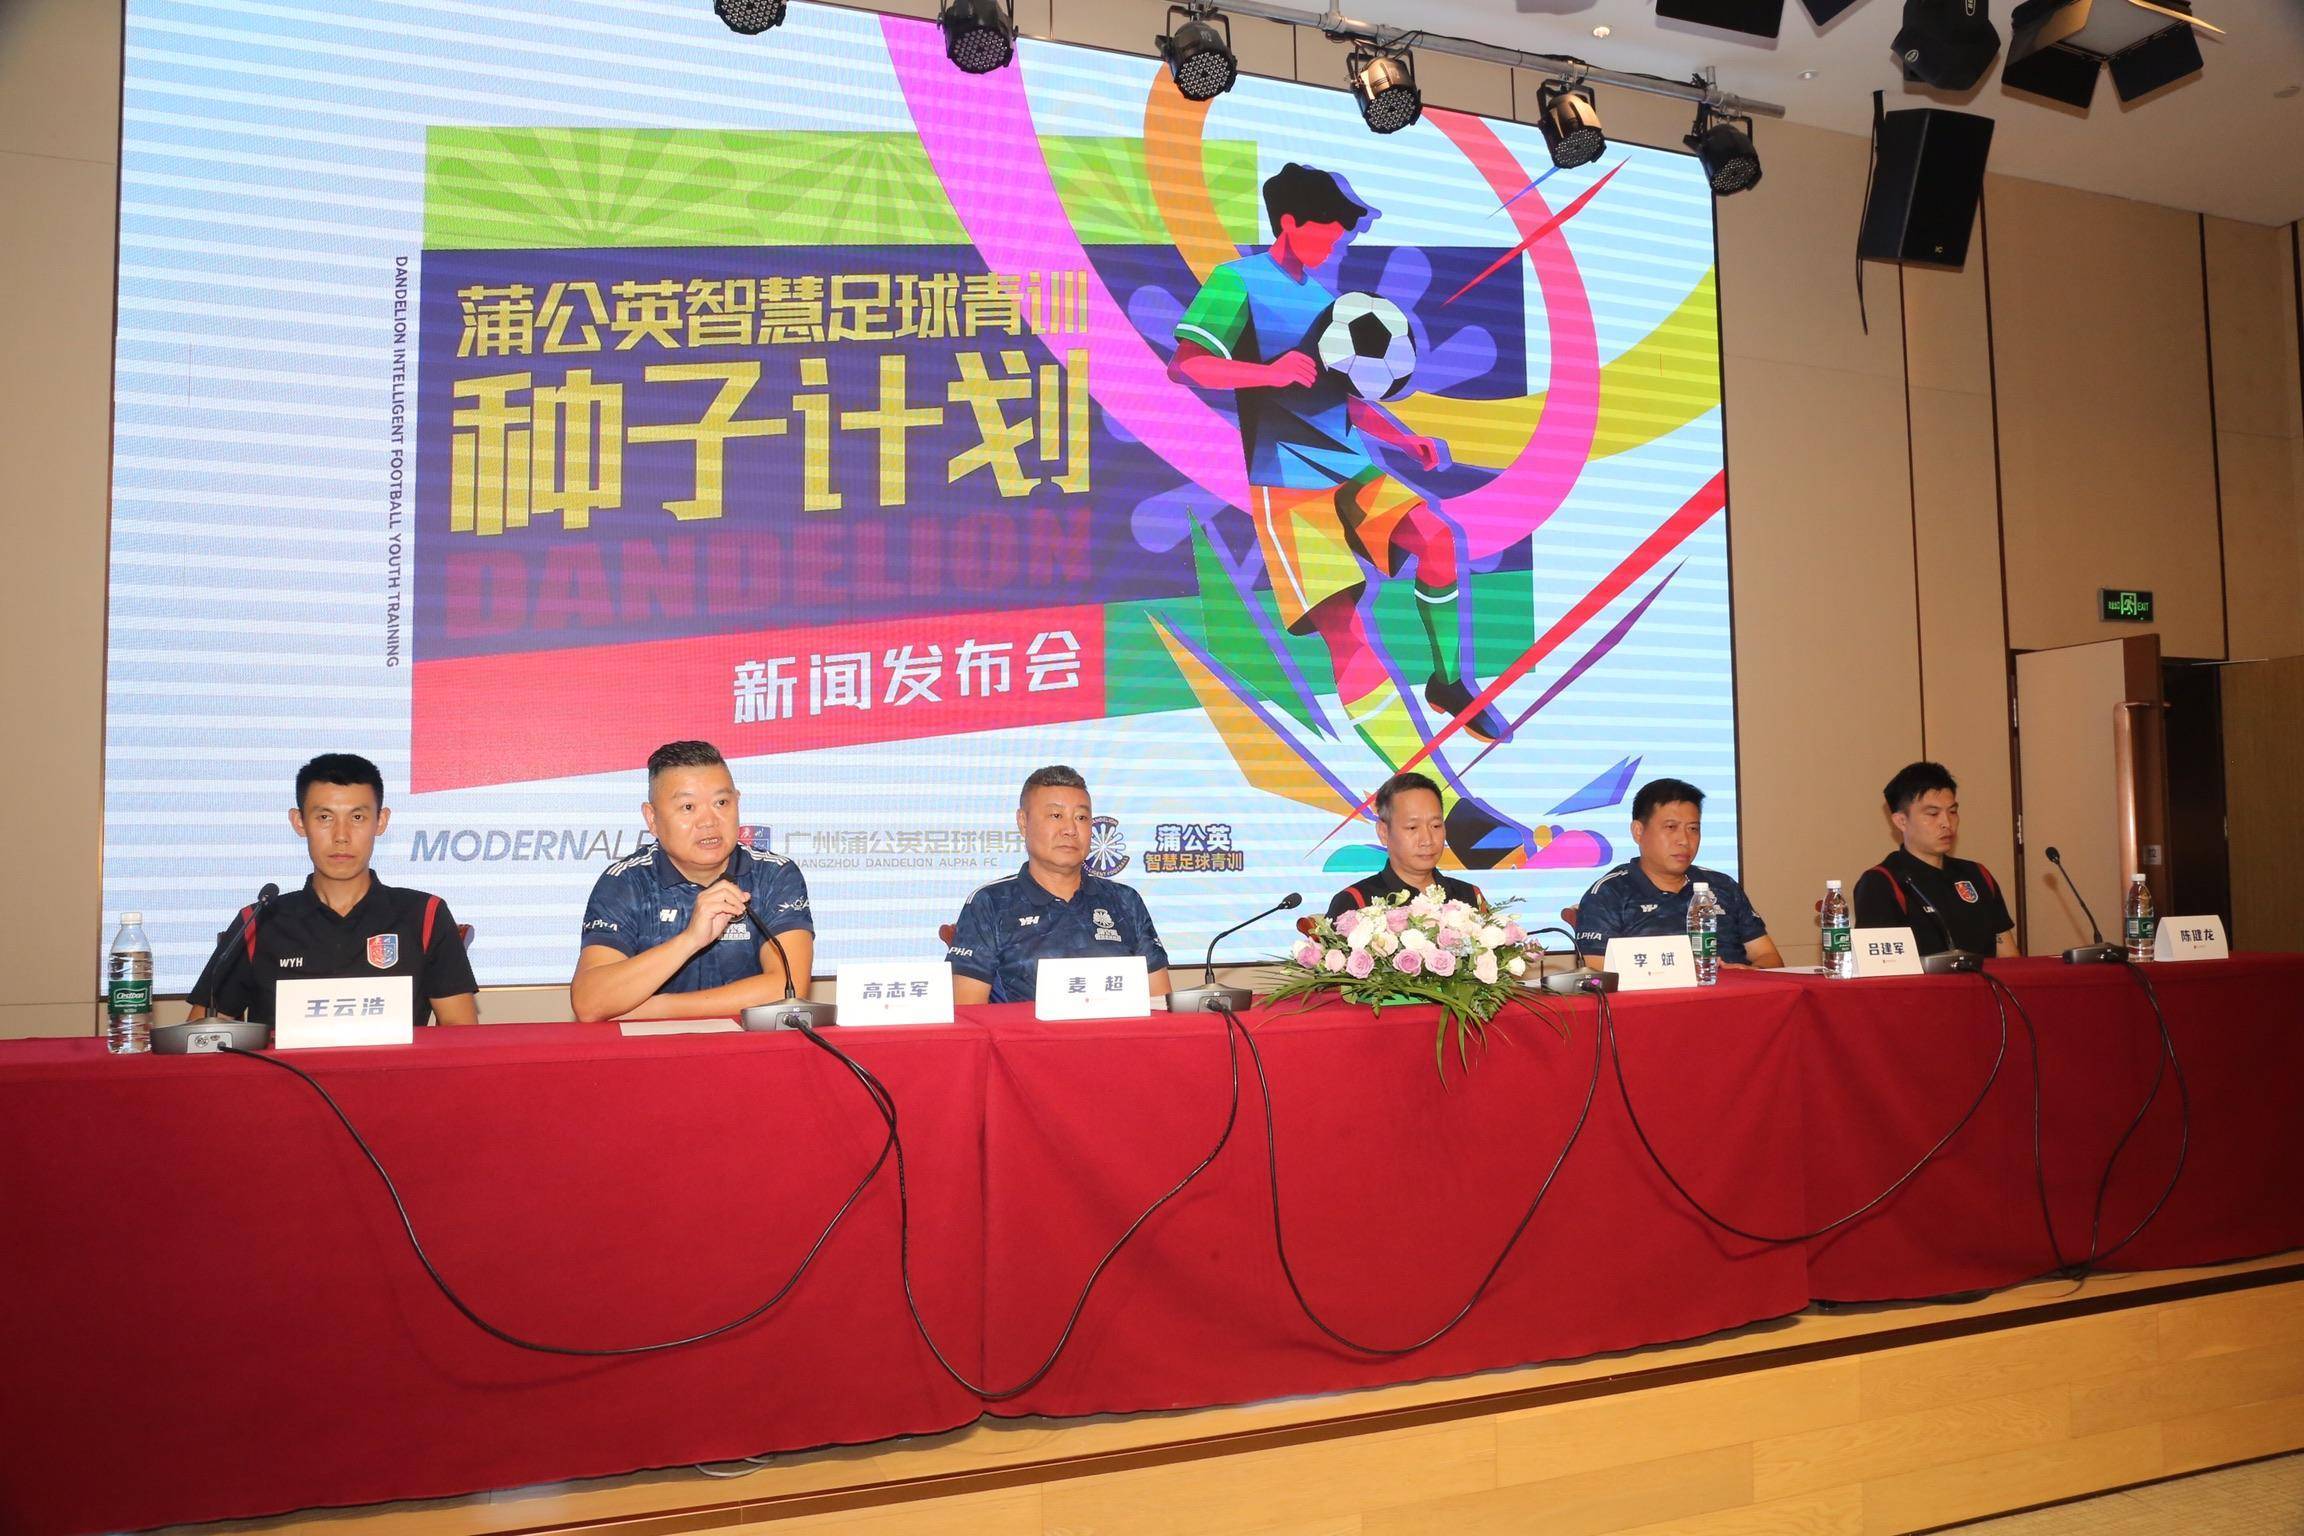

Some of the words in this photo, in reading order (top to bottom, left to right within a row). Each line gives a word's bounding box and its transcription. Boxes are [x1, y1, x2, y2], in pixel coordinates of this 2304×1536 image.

[393, 256, 408, 344] DANDELION
[457, 270, 1090, 357] 蒲公英智慧足球青训
[391, 348, 406, 444] INTELLIGENT
[450, 348, 1092, 536] 种子计划
[389, 449, 404, 529] FOOTBALL
[387, 534, 402, 588] YOUTH
[445, 506, 1094, 639] DANDELION
[386, 592, 400, 667] TRAINING
[733, 630, 1082, 725] 新闻发布会
[1156, 825, 1232, 852] 蒲公英
[865, 857, 933, 869] DANDELION
[939, 857, 977, 868] ALPHA
[983, 857, 998, 867] FC
[1145, 852, 1243, 872] 智慧足球青训
[1577, 932, 1602, 940] LPHA
[1868, 942, 1905, 956] 吕建军
[279, 957, 303, 968] WYH
[862, 981, 929, 1000] 高志军
[1067, 975, 1123, 994] 麦超
[304, 996, 385, 1018] 王云浩
